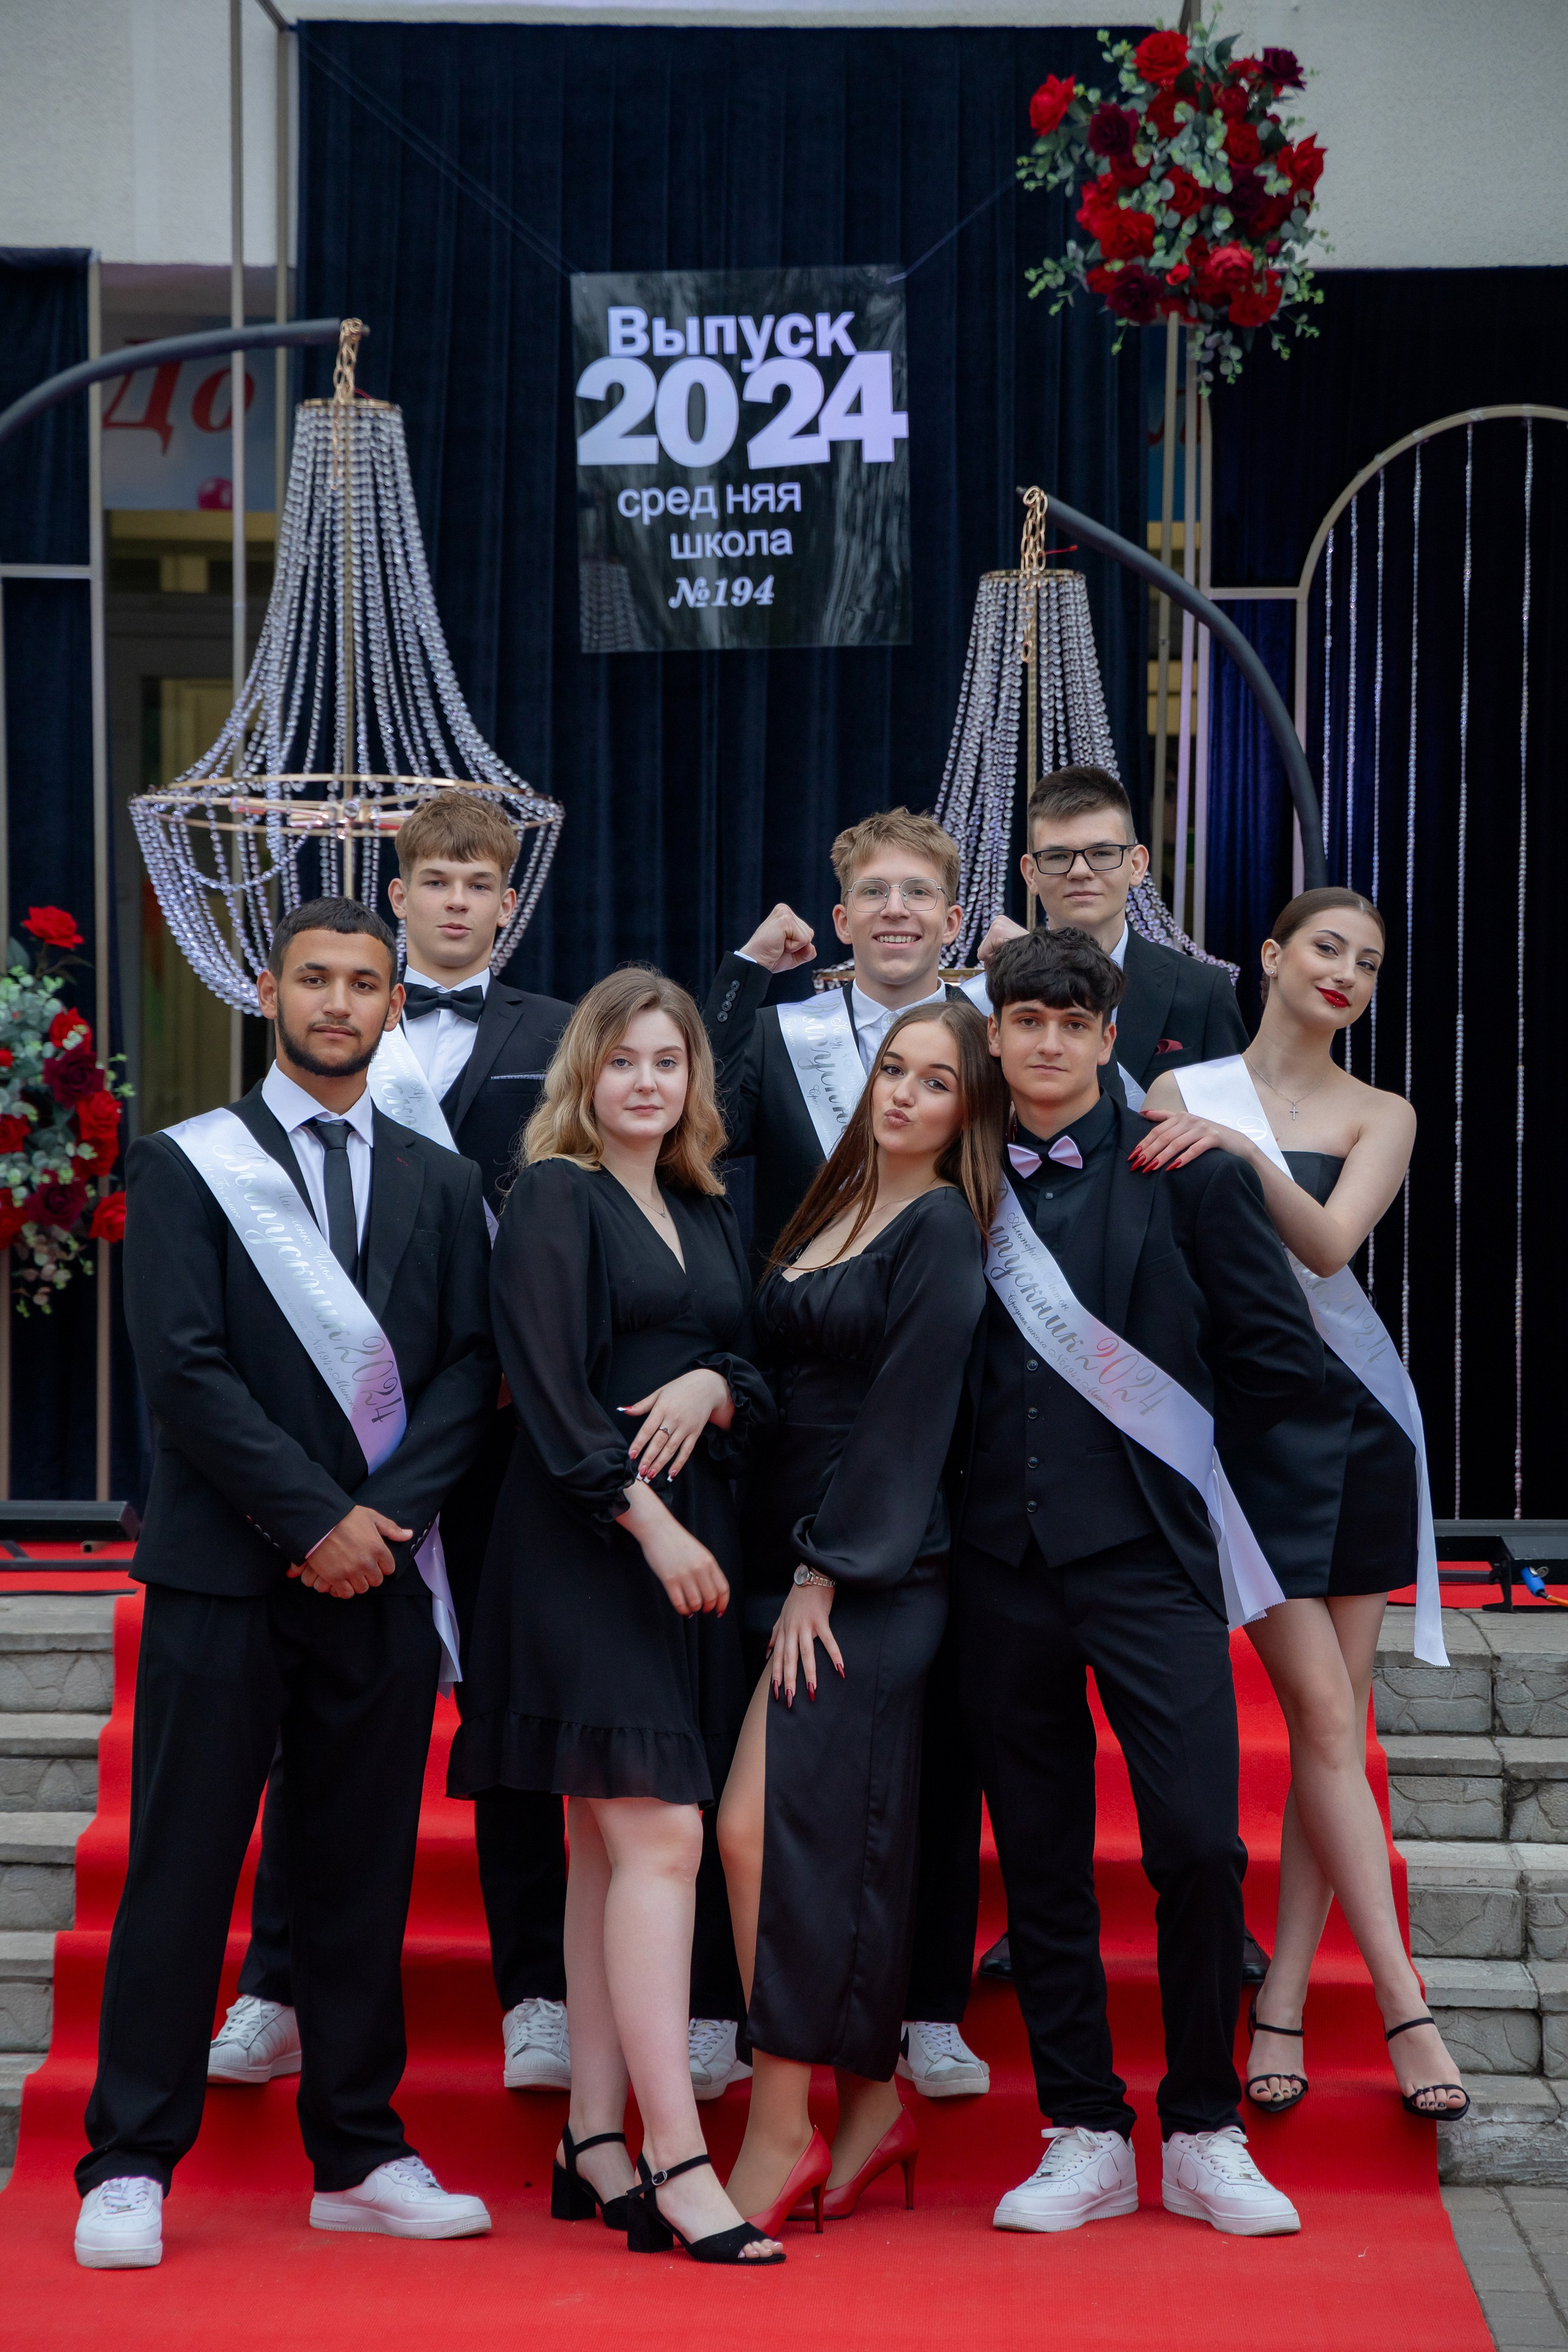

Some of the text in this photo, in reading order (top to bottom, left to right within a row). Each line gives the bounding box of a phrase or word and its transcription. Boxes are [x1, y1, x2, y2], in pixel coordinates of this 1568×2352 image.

[607, 306, 857, 373] Выпуск
[576, 350, 909, 470] 2024
[669, 528, 793, 559] школа
[668, 575, 775, 608] №194
[797, 997, 849, 1133] Выпускн
[223, 1196, 241, 1219] класс
[212, 1144, 351, 1341] Выпускник
[313, 1247, 334, 1281] Илья
[1008, 1289, 1028, 1327] Средняя
[1027, 1325, 1047, 1350] школа
[1043, 1271, 1070, 1312] Антон
[334, 1336, 402, 1423] 2024
[1075, 1337, 1173, 1416] 2024
